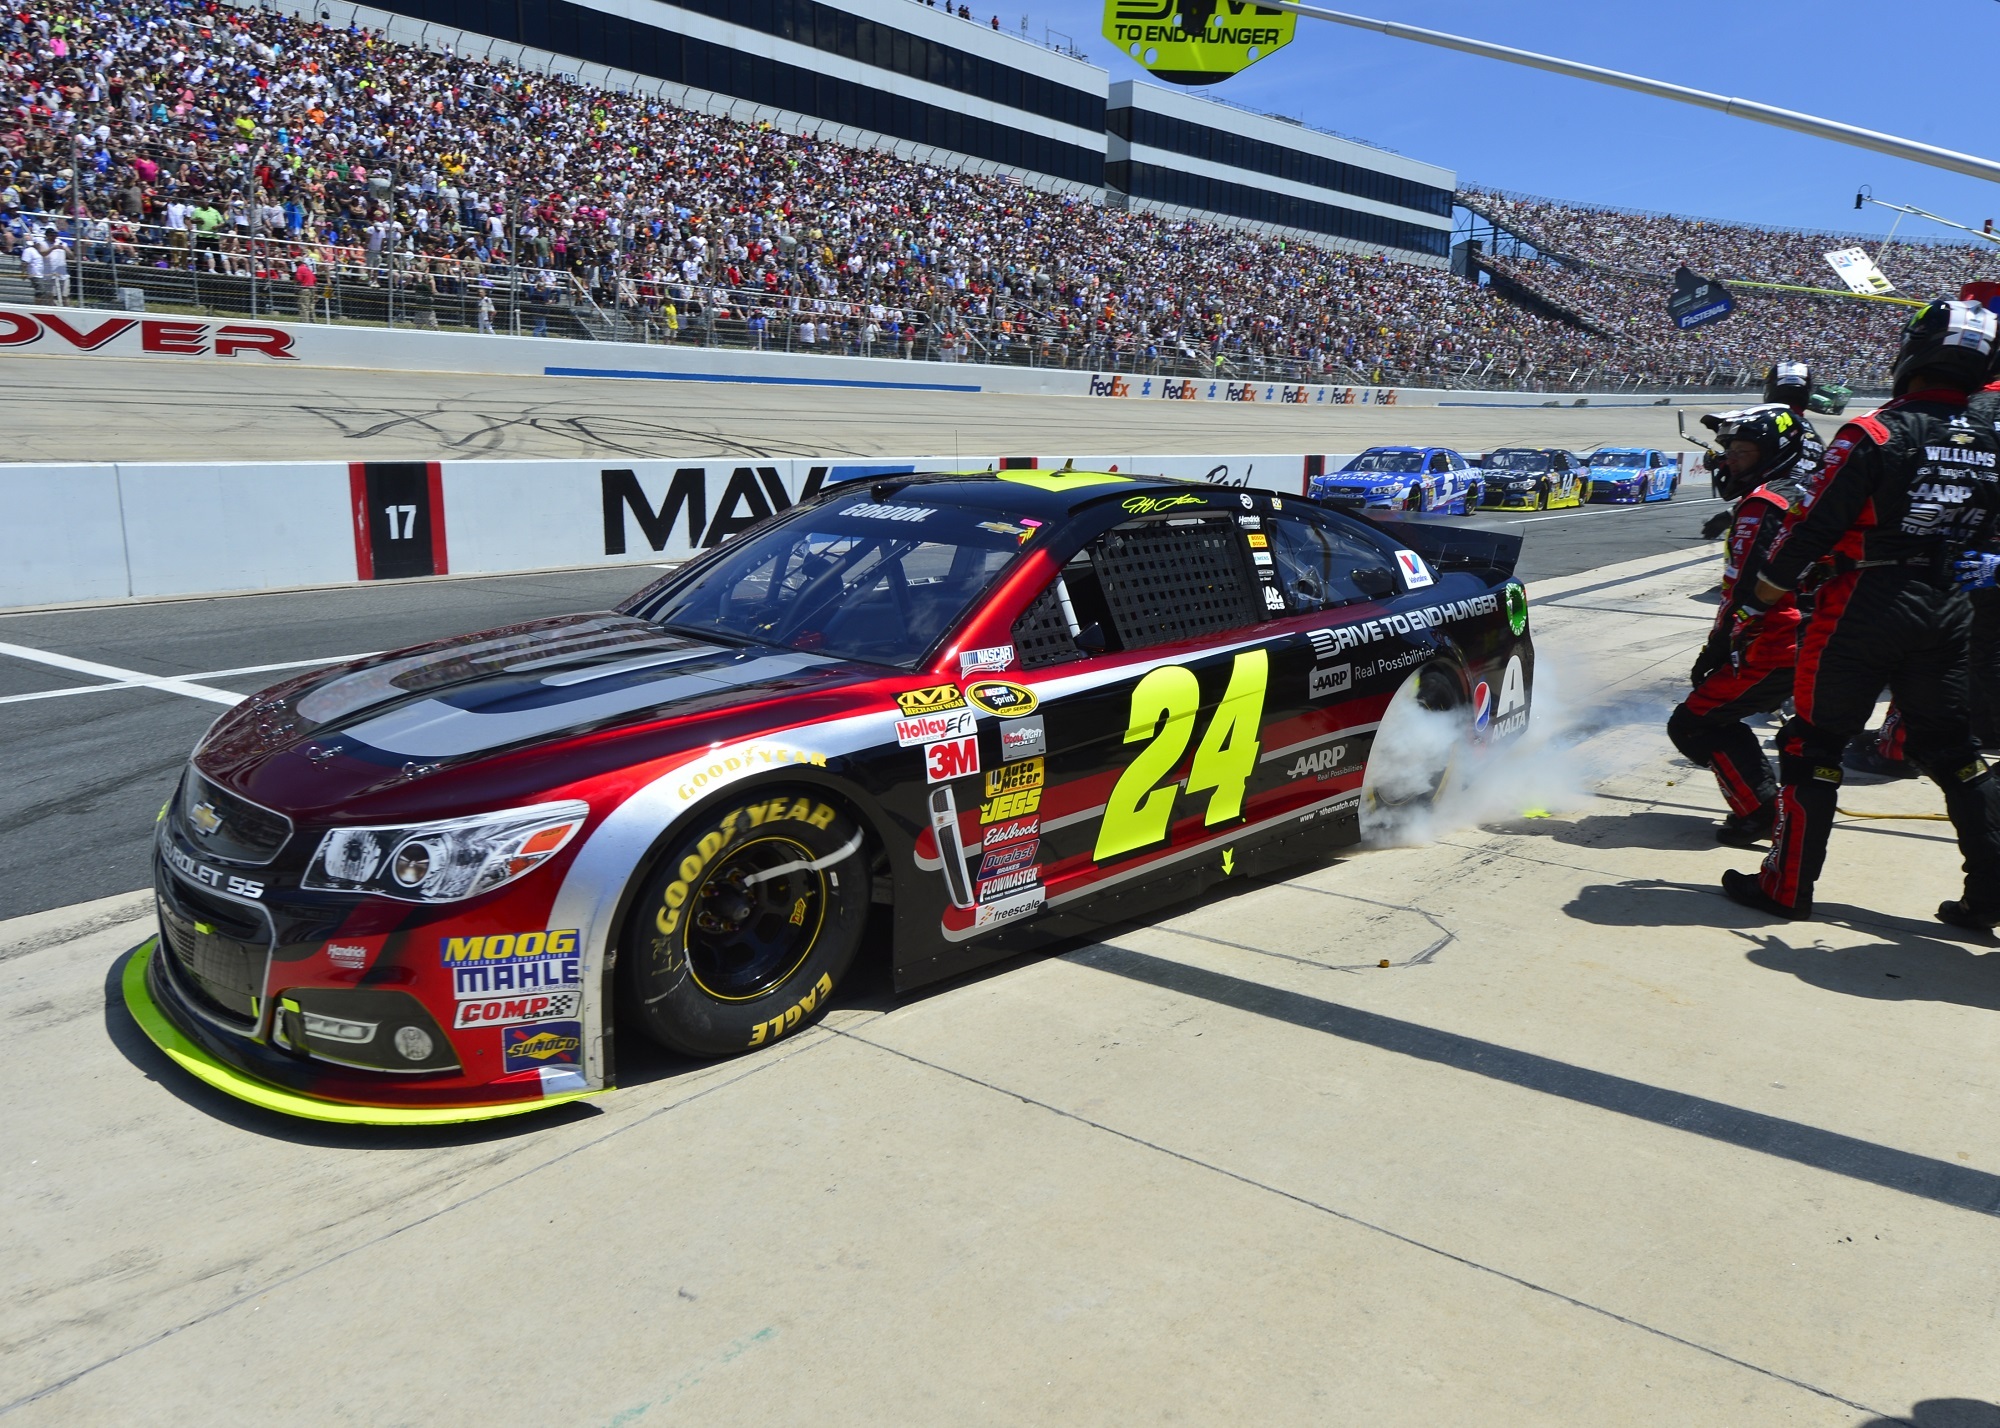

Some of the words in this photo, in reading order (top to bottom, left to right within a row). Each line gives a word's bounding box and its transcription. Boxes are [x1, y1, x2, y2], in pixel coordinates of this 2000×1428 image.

[1115, 25, 1142, 41] TO
[1694, 285, 1709, 298] 99
[1681, 303, 1728, 328] FASTENAL
[1089, 374, 1130, 397] FedEx
[1162, 379, 1198, 400] FedEx
[1226, 383, 1257, 402] FedEx
[1281, 386, 1309, 404] FedEx
[1331, 387, 1355, 405] FedEx
[1374, 389, 1398, 405] FedEx
[1775, 412, 1794, 433] 24
[1924, 446, 1996, 468] WILLIAMS
[1437, 473, 1455, 506] 5
[1558, 473, 1574, 499] 14
[1907, 482, 1973, 504] AARP
[385, 505, 417, 540] 17
[839, 502, 938, 522] GORDON
[1306, 620, 1385, 660] DRIVE
[1379, 614, 1411, 638] TO
[1406, 606, 1444, 632] END
[1440, 594, 1499, 622] HUNGER
[977, 646, 1013, 664] NASCAR
[1312, 669, 1349, 692] AARP
[1354, 661, 1376, 681] Real
[1378, 646, 1436, 673] Possibilities
[984, 686, 1009, 697] NASCAR
[992, 694, 1016, 706] Sprint
[902, 704, 946, 715] MECHANIX
[943, 698, 966, 711] WEAR
[1000, 706, 1014, 714] CUP
[1013, 704, 1032, 713] SERIES
[896, 718, 947, 740] Holley
[1023, 728, 1043, 739] LIGHT
[1491, 710, 1527, 743] AXALTA
[1009, 738, 1037, 748] POLE
[928, 738, 978, 780] 3M
[1092, 648, 1268, 862] 24
[1286, 745, 1346, 779] AARP
[677, 745, 828, 801] GOODYEAR
[1003, 762, 1034, 778] Auto
[1317, 772, 1330, 782] Real
[1330, 763, 1363, 778] Possibilities
[1001, 772, 1041, 793] Meter
[980, 787, 1042, 825] JEGS
[983, 818, 1039, 847] Edelbrock
[656, 797, 836, 936] GOODYEAR
[985, 844, 1035, 869] Duralast
[996, 862, 1020, 875] BRAKES
[226, 875, 265, 899] SS
[980, 866, 1038, 903] FLOWMASTER
[993, 898, 1041, 922] freescale
[444, 929, 577, 962] MOOG
[451, 959, 496, 967] STEERING
[512, 953, 569, 963] SUSPENSION
[456, 959, 579, 993] MAHLE
[518, 986, 544, 994] ENGINE
[461, 997, 550, 1022] COMP
[522, 1008, 565, 1020] CAMS
[748, 971, 834, 1047] EAGLE
[510, 1037, 579, 1057] SUNOCO
